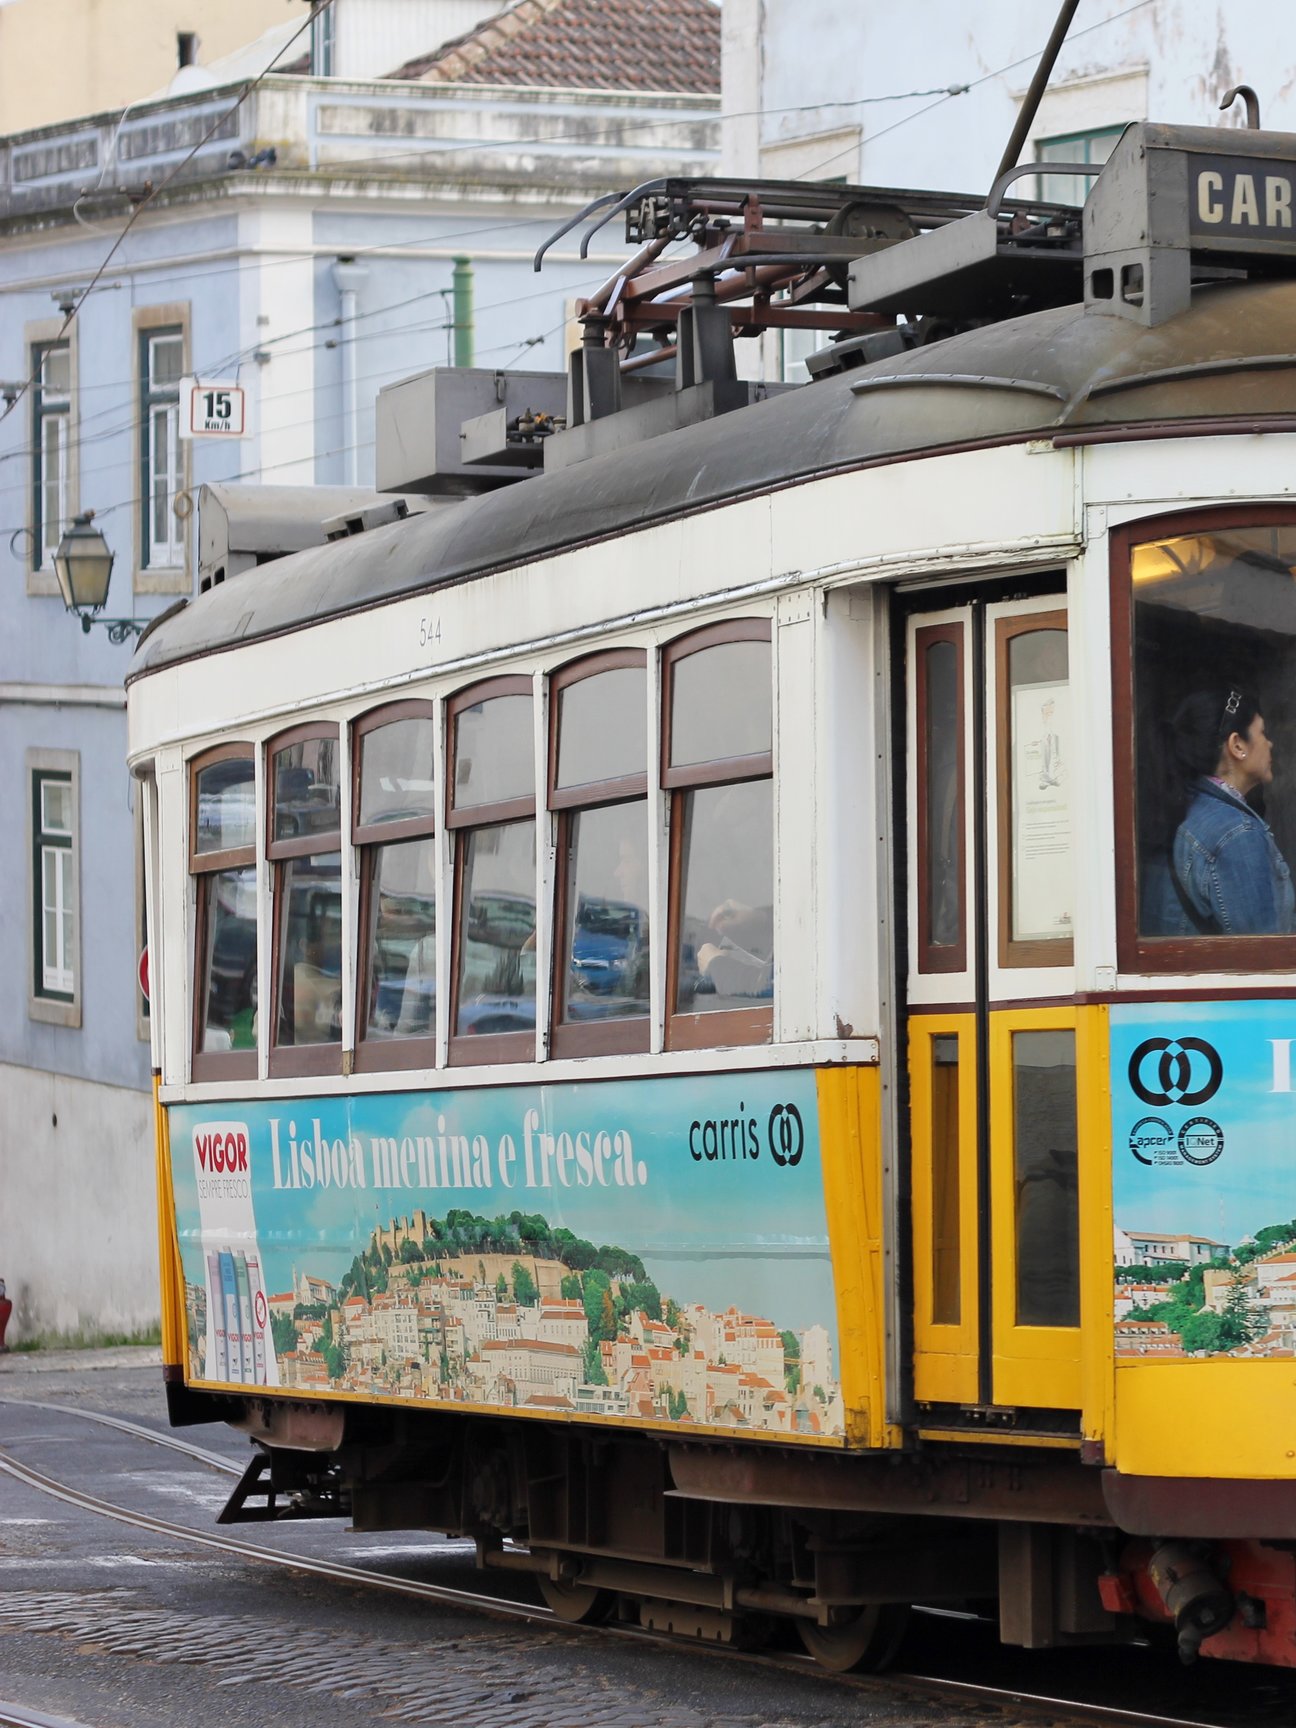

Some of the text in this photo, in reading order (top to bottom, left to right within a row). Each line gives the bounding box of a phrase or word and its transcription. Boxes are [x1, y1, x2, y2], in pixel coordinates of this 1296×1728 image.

[203, 391, 231, 418] 15
[205, 420, 230, 430] Km/h
[419, 616, 441, 647] 544
[689, 1101, 760, 1162] carris
[1137, 1136, 1167, 1148] apcer
[195, 1132, 248, 1173] VIGOR
[268, 1108, 648, 1190] Lisboa menina e fresca.
